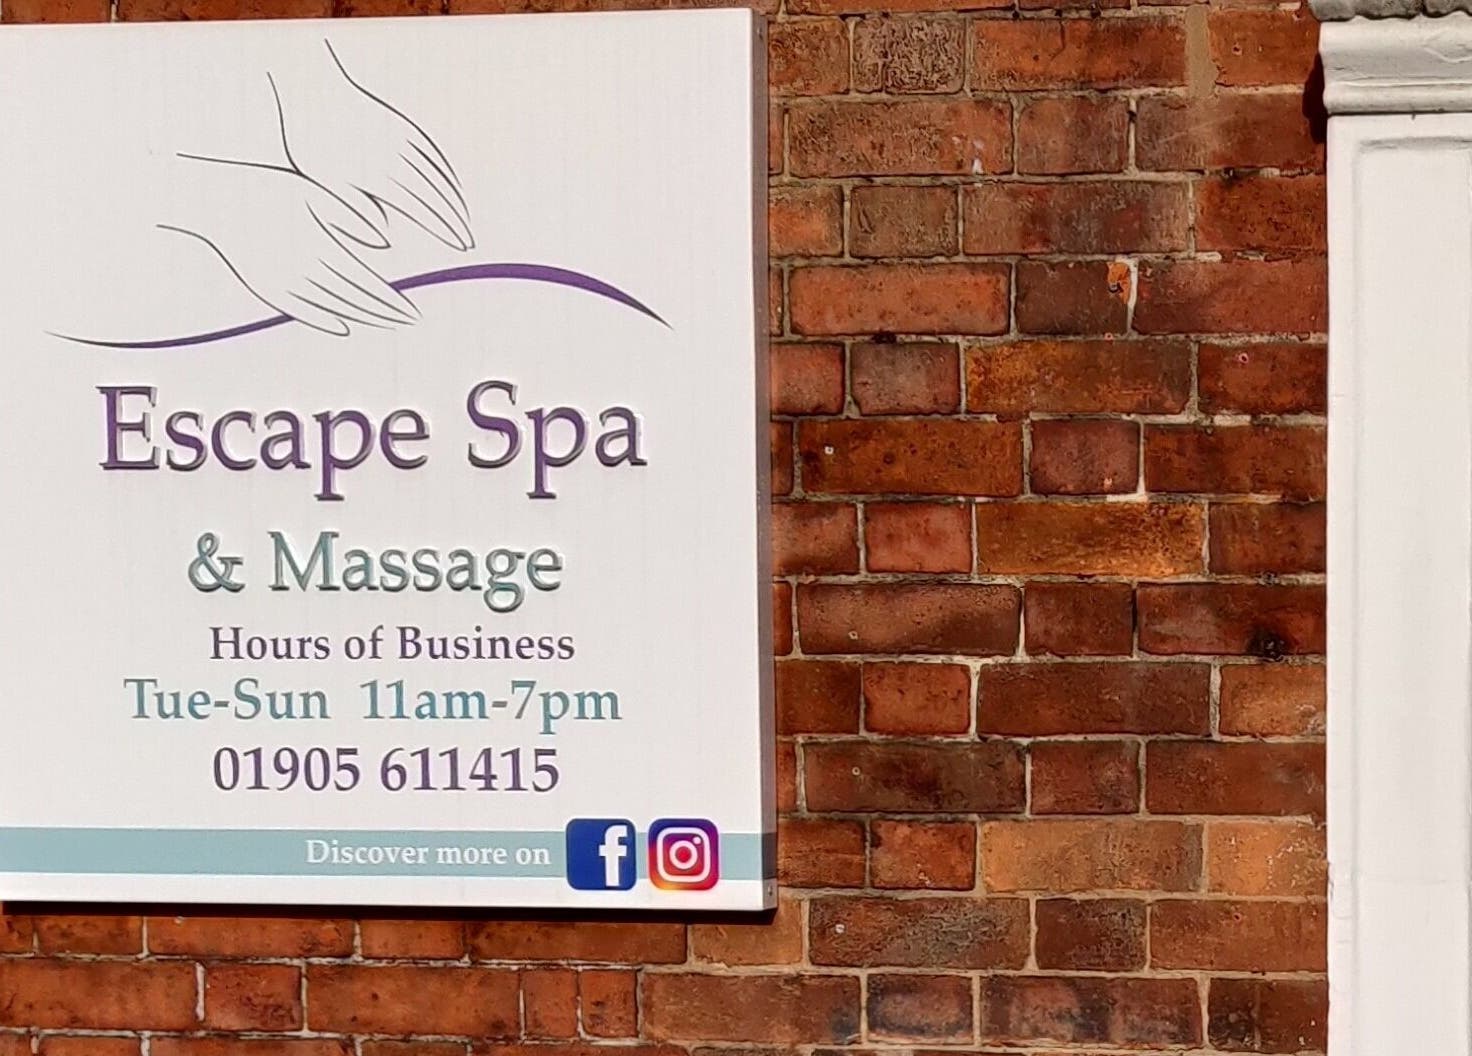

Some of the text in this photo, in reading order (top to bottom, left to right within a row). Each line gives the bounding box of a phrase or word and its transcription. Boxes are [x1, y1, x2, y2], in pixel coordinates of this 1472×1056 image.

[96, 380, 648, 501] Escape Spa
[187, 531, 563, 613] & Massage
[209, 626, 576, 660] Hours of Business
[123, 677, 623, 735] Tue-Sun 11am-7pm
[212, 746, 561, 792] 01905 611415
[305, 839, 551, 865] Discover more on
